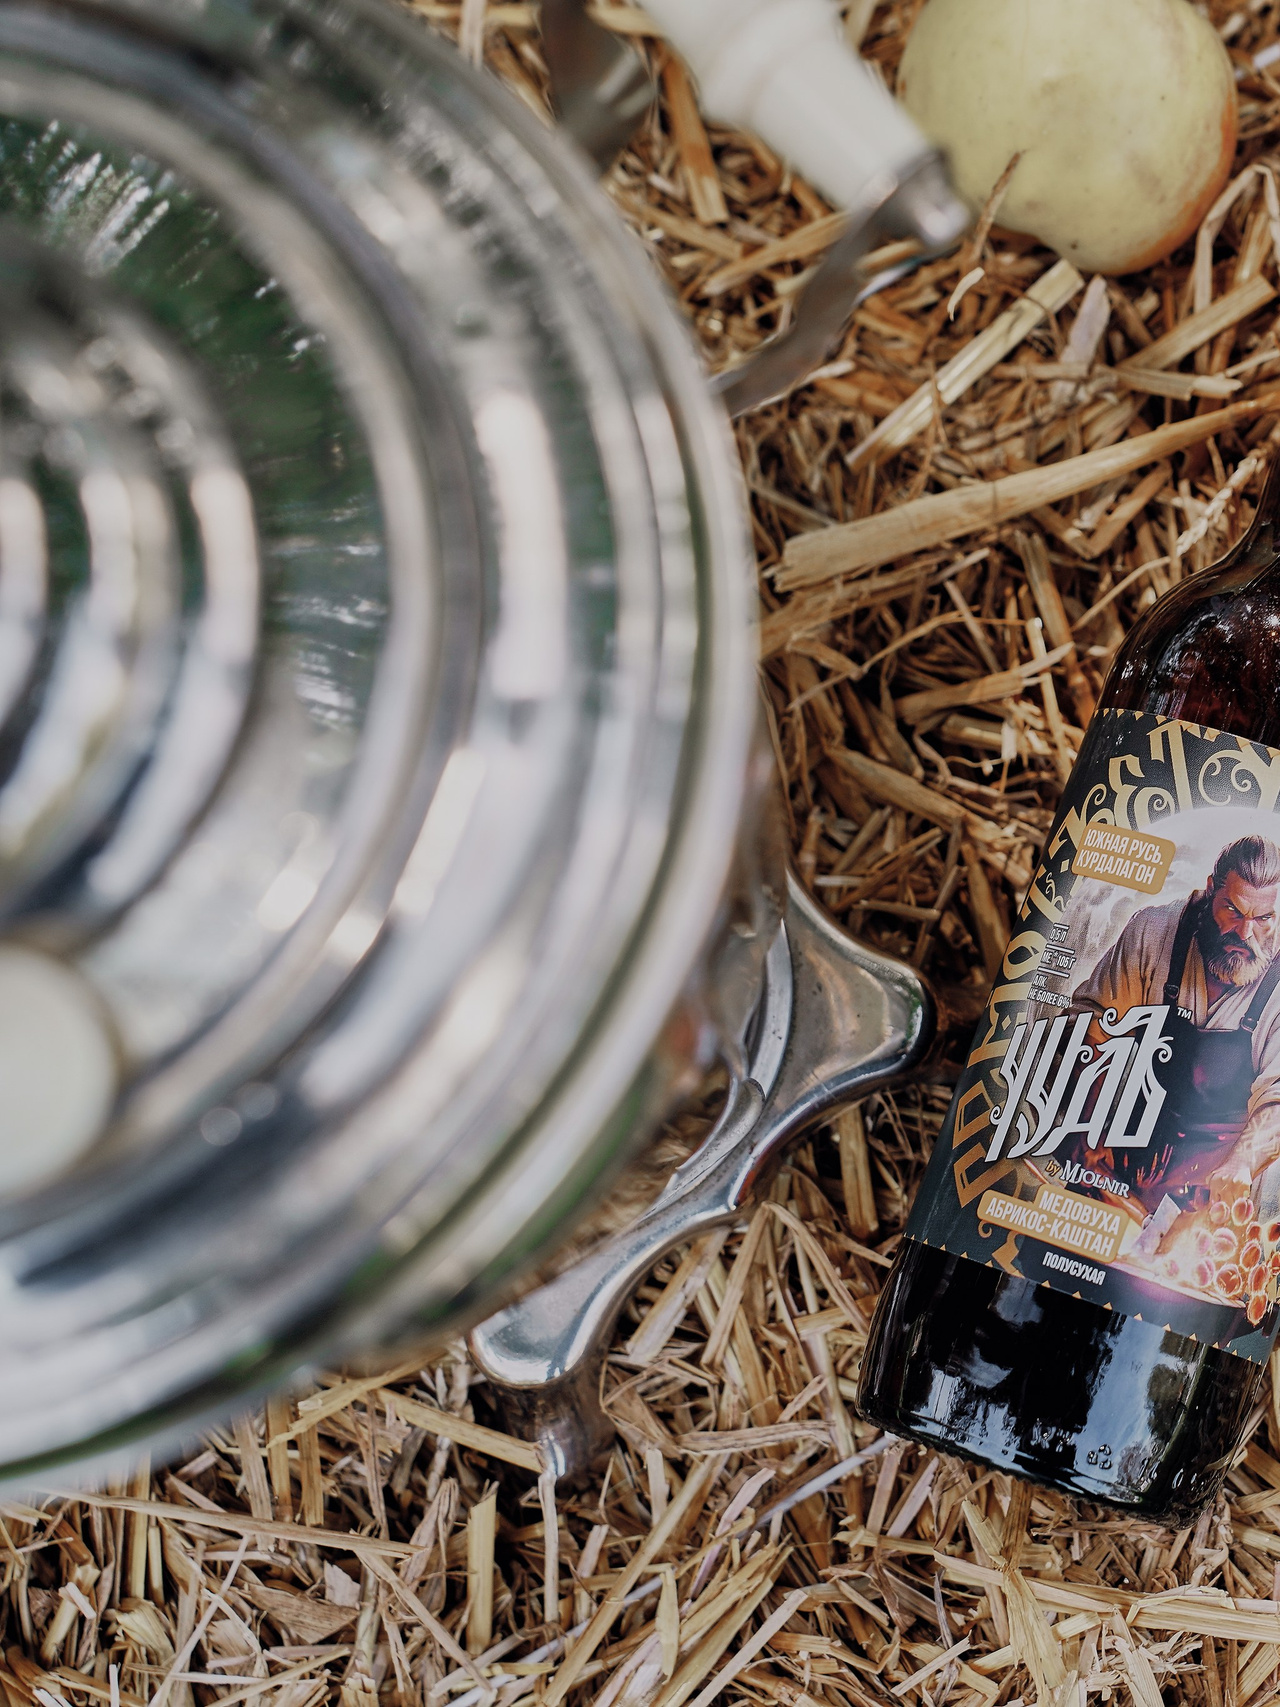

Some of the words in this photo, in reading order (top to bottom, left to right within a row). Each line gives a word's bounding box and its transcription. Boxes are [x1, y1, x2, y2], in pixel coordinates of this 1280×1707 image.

[1084, 829, 1129, 854] ЮЖНАЯ
[1128, 839, 1163, 865] РУСЬ.
[1076, 849, 1156, 885] КУРДАЛАГОН
[1037, 989, 1058, 1006] БОЛЕЕ
[1045, 1160, 1060, 1175] by
[1060, 1160, 1130, 1198] MJOLNIR
[985, 1197, 1115, 1257] АБРИКОС-КАШТАН
[1039, 1191, 1121, 1235] МЕДОВУХА
[1042, 1251, 1106, 1286] ПОЛУСУХАЯ
